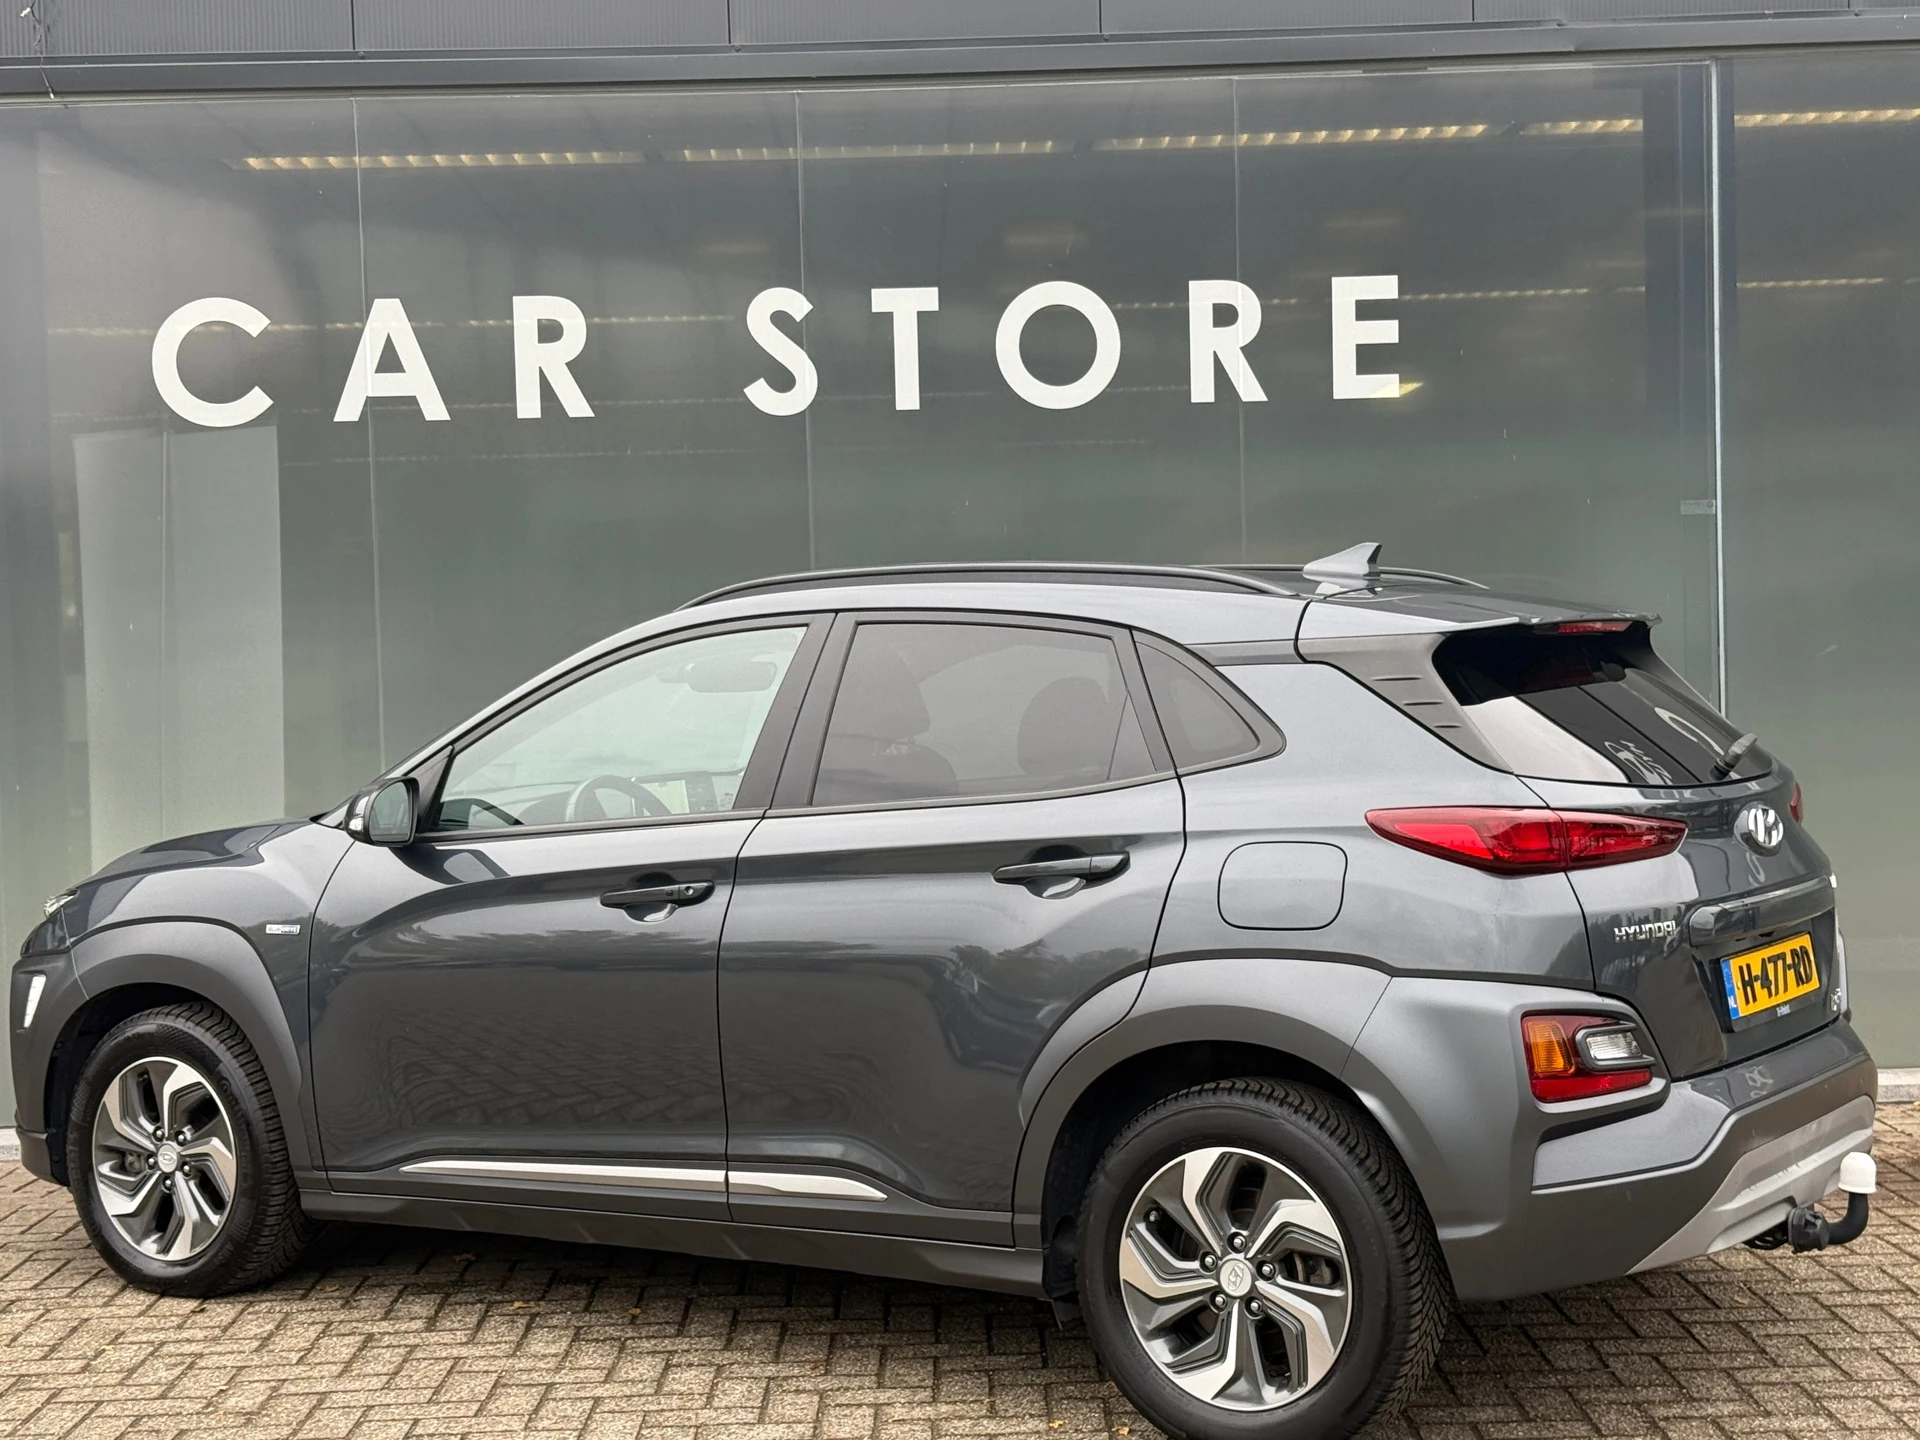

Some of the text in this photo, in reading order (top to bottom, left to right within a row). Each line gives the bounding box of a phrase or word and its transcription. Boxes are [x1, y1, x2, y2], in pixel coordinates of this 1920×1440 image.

[152, 275, 1400, 427] CAR STORE
[1613, 920, 1676, 943] HYUNDAI
[1738, 945, 1813, 1007] H-477-RD
